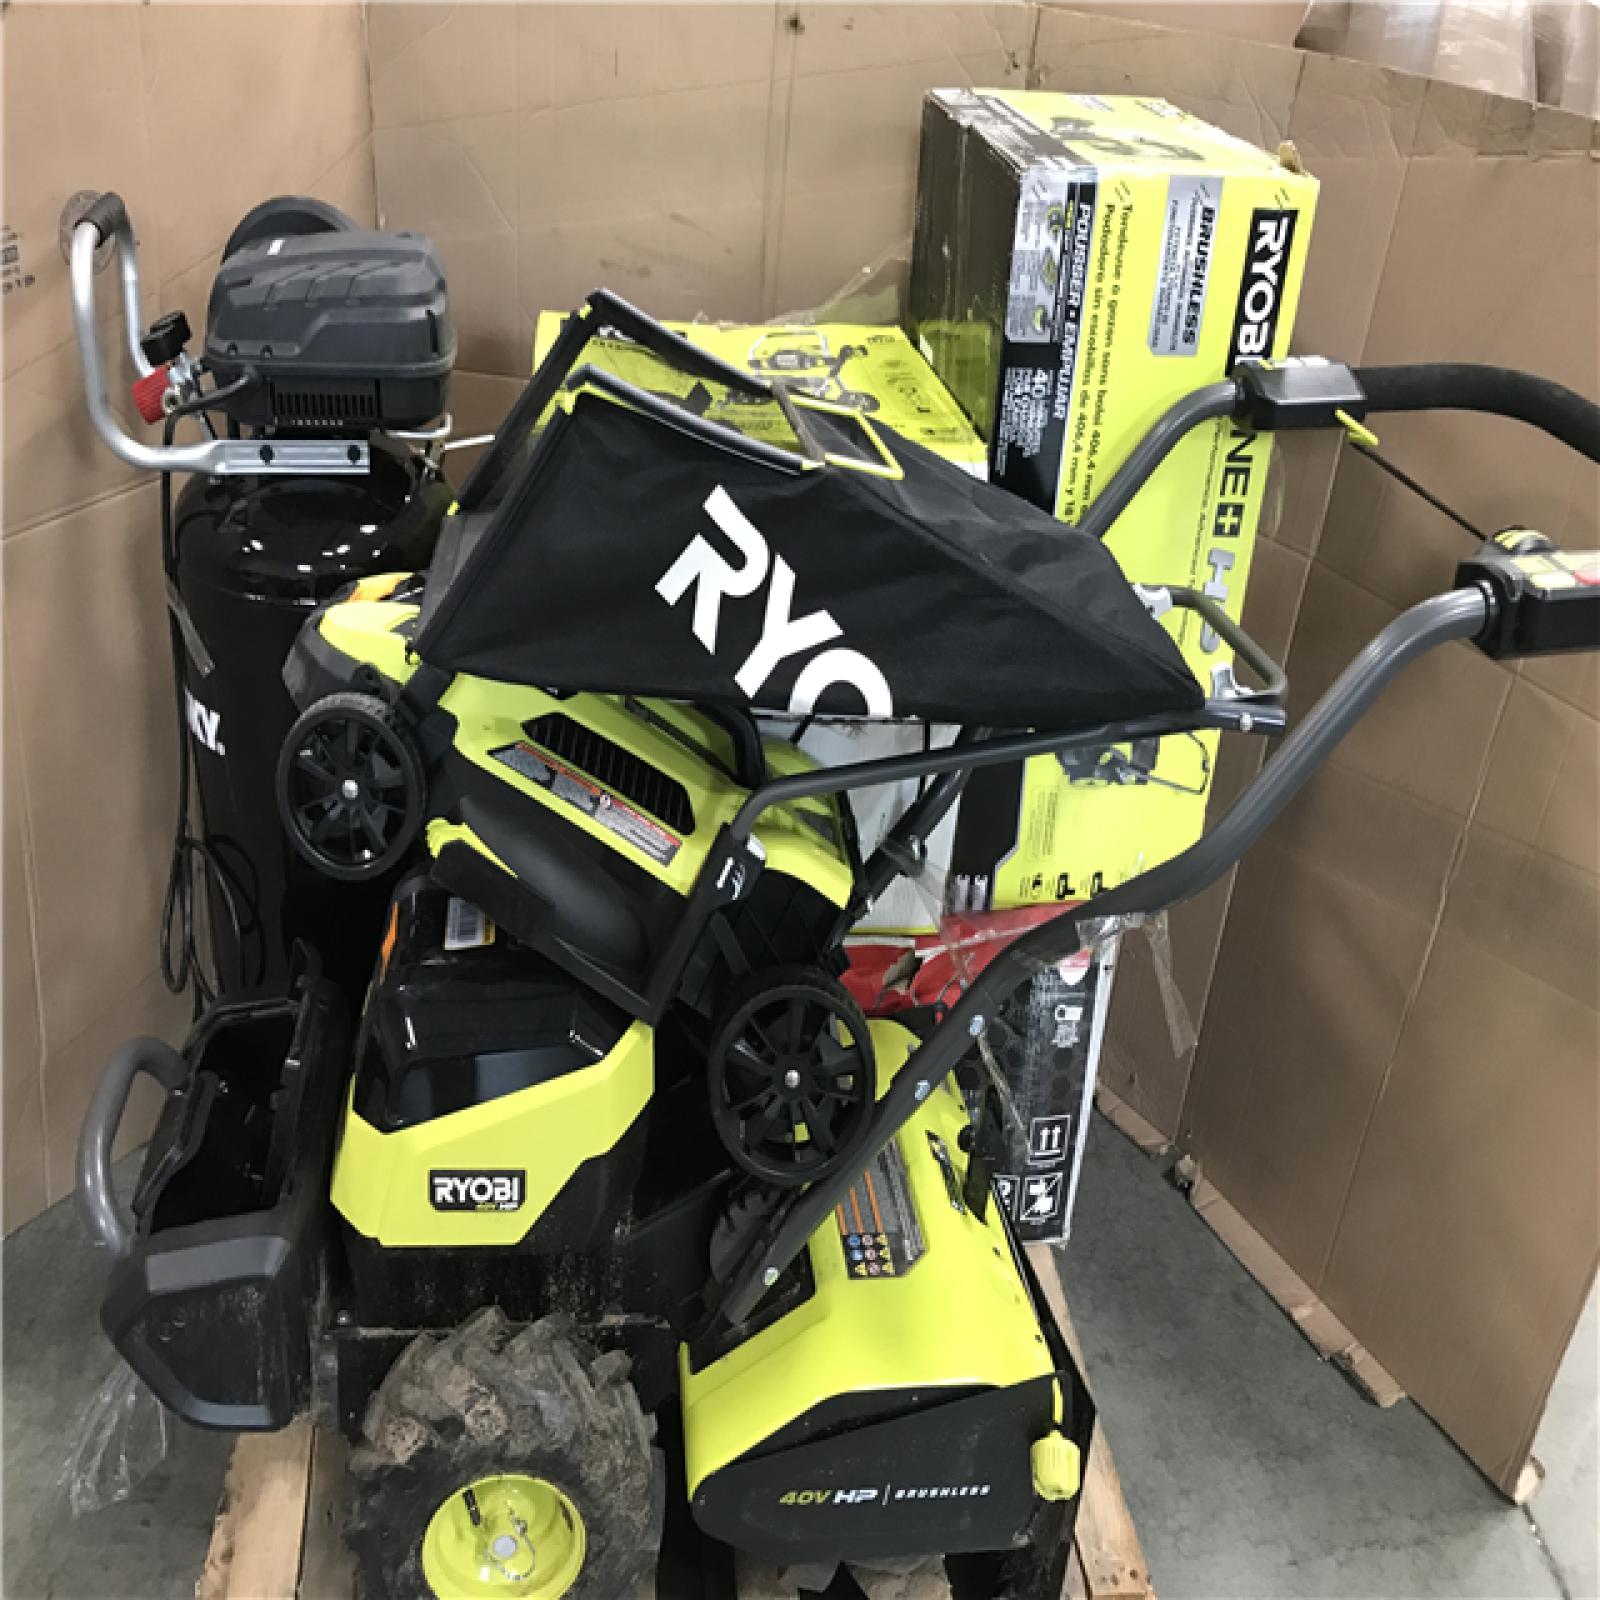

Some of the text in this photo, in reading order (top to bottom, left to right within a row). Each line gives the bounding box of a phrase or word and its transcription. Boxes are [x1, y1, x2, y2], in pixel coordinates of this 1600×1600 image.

[1069, 202, 1090, 306] POUSSER
[1182, 206, 1215, 344] BRUSHLESS
[1053, 321, 1076, 420] EMPUJAR
[433, 1176, 521, 1203] RYOBI
[778, 1489, 830, 1506] 40V
[832, 1488, 880, 1505] HP
